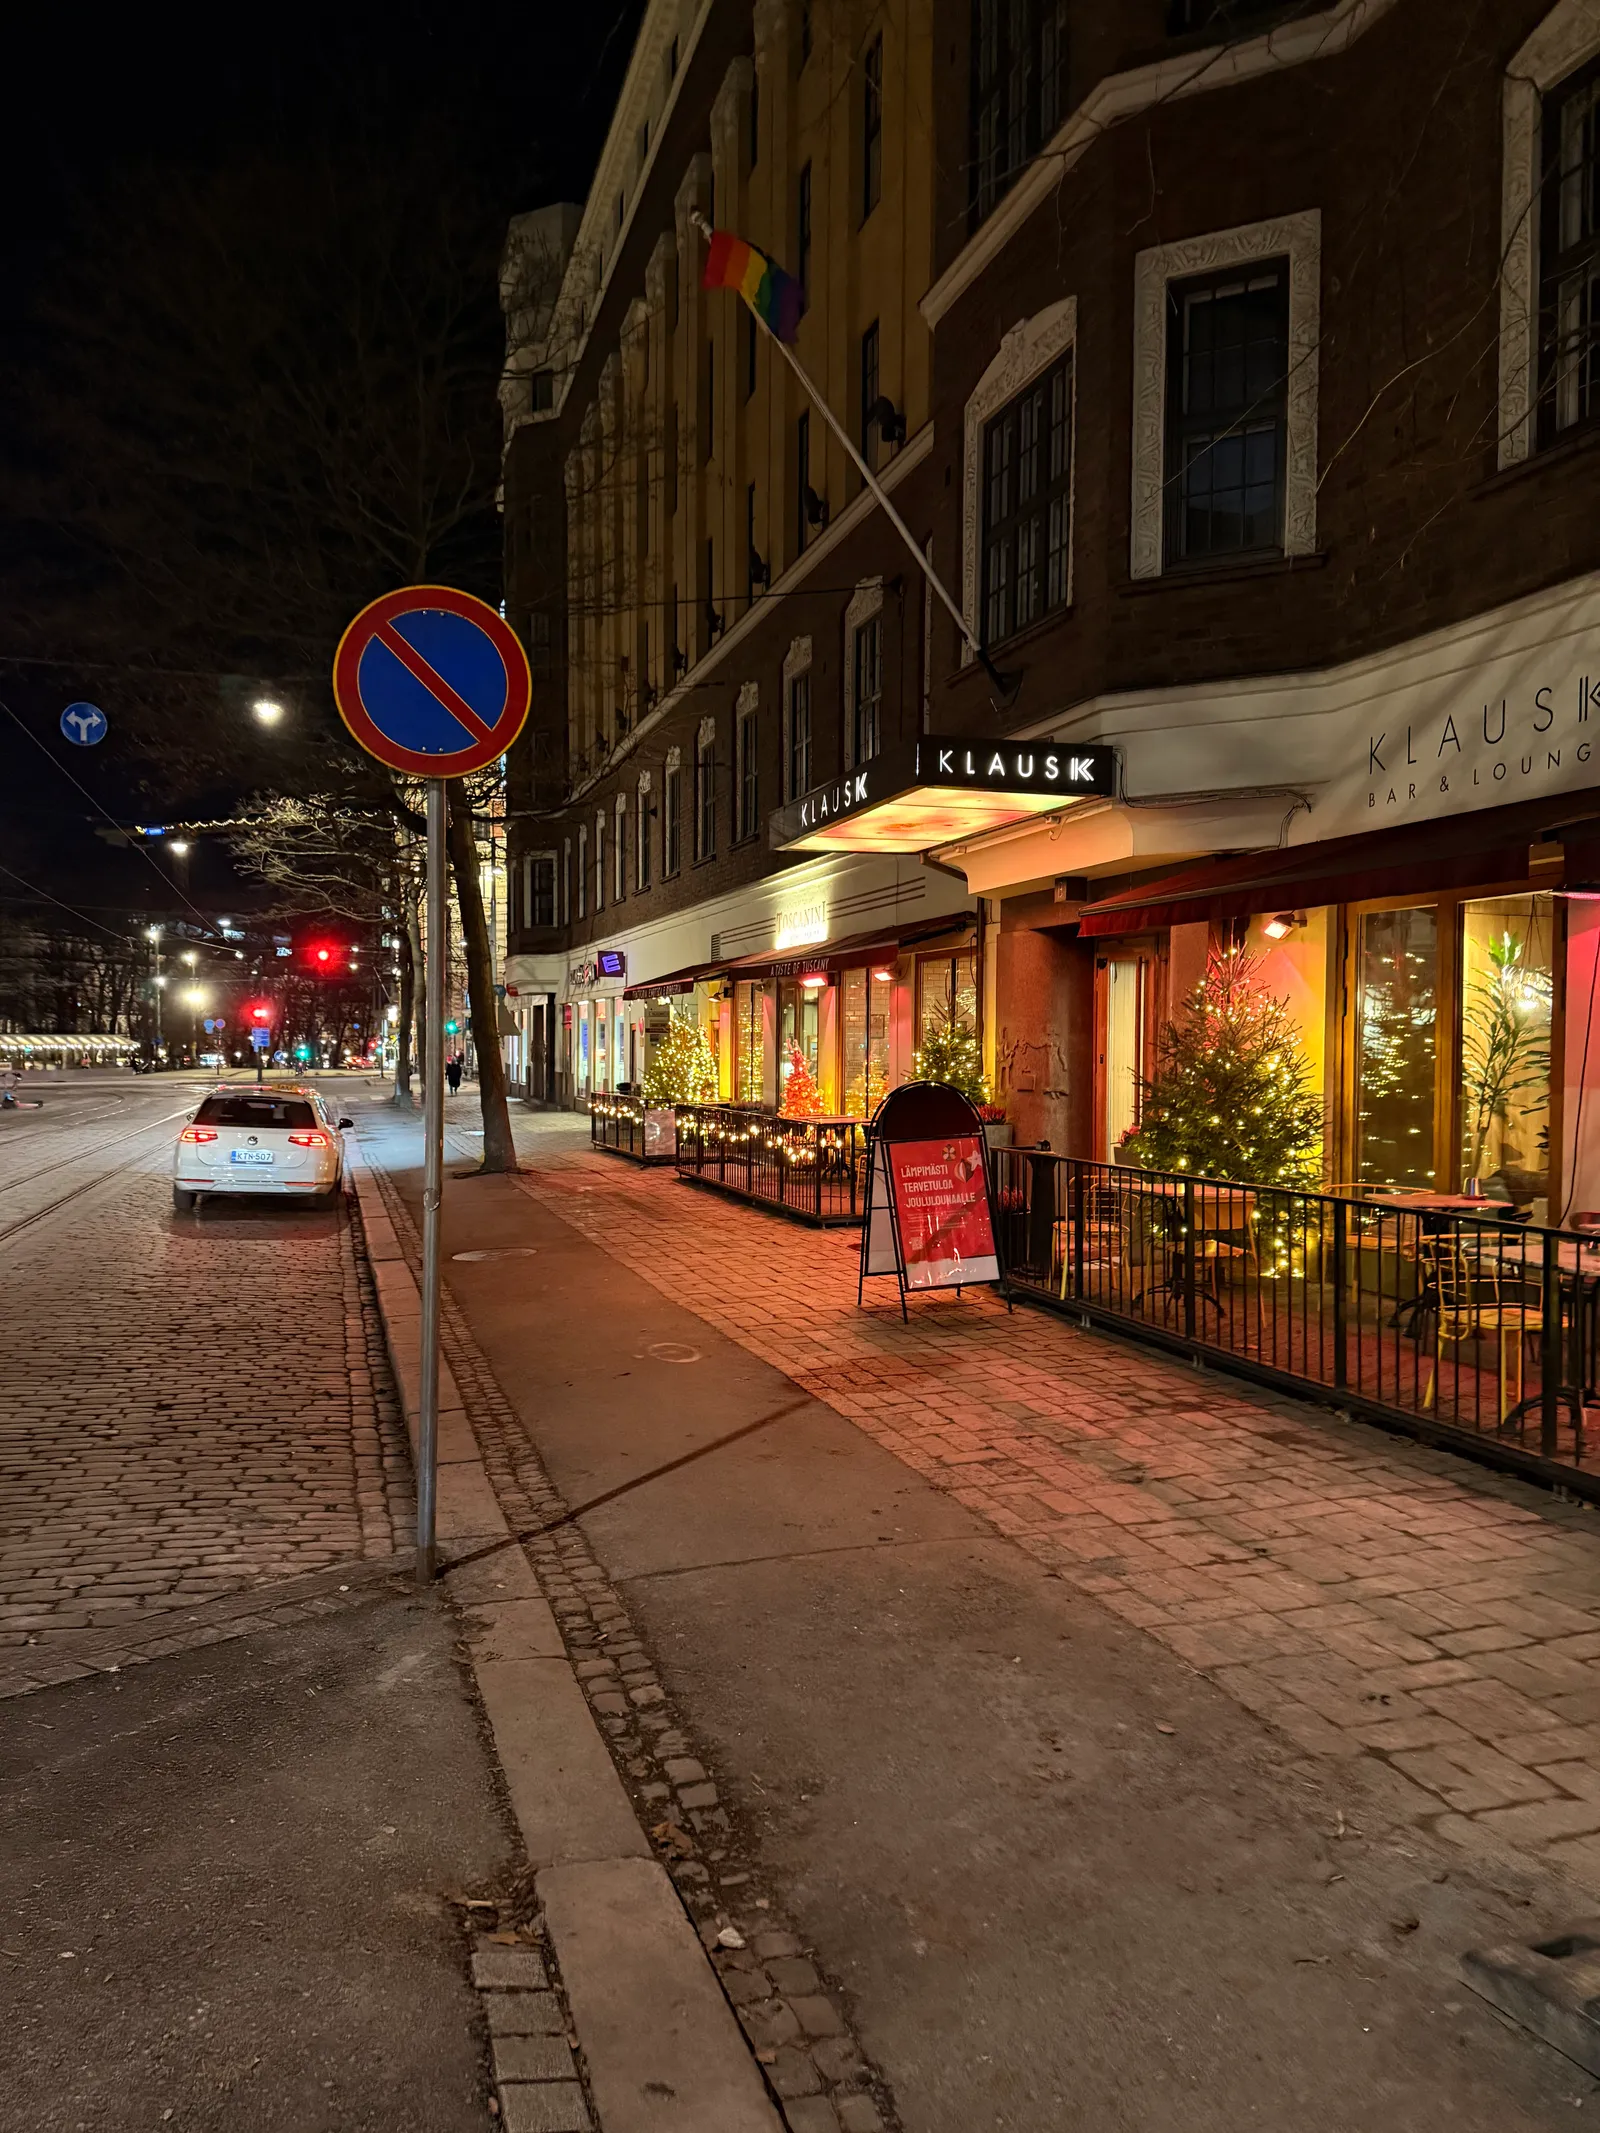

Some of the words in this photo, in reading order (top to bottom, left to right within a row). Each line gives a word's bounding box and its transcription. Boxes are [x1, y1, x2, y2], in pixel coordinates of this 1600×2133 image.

[1368, 783, 1416, 808] BAR
[1439, 775, 1450, 792] &
[1473, 742, 1591, 786] LOUNG
[776, 901, 826, 934] TOSCANINI
[775, 963, 791, 976] TASTE
[792, 961, 800, 975] OF
[802, 957, 830, 973] TUSCANY
[237, 1152, 271, 1161] KTN-507
[901, 1163, 948, 1178] LÄMPIMÄSTI
[903, 1179, 953, 1193] TERVETULOA
[906, 1192, 976, 1208] JOULULOUNAALLE
